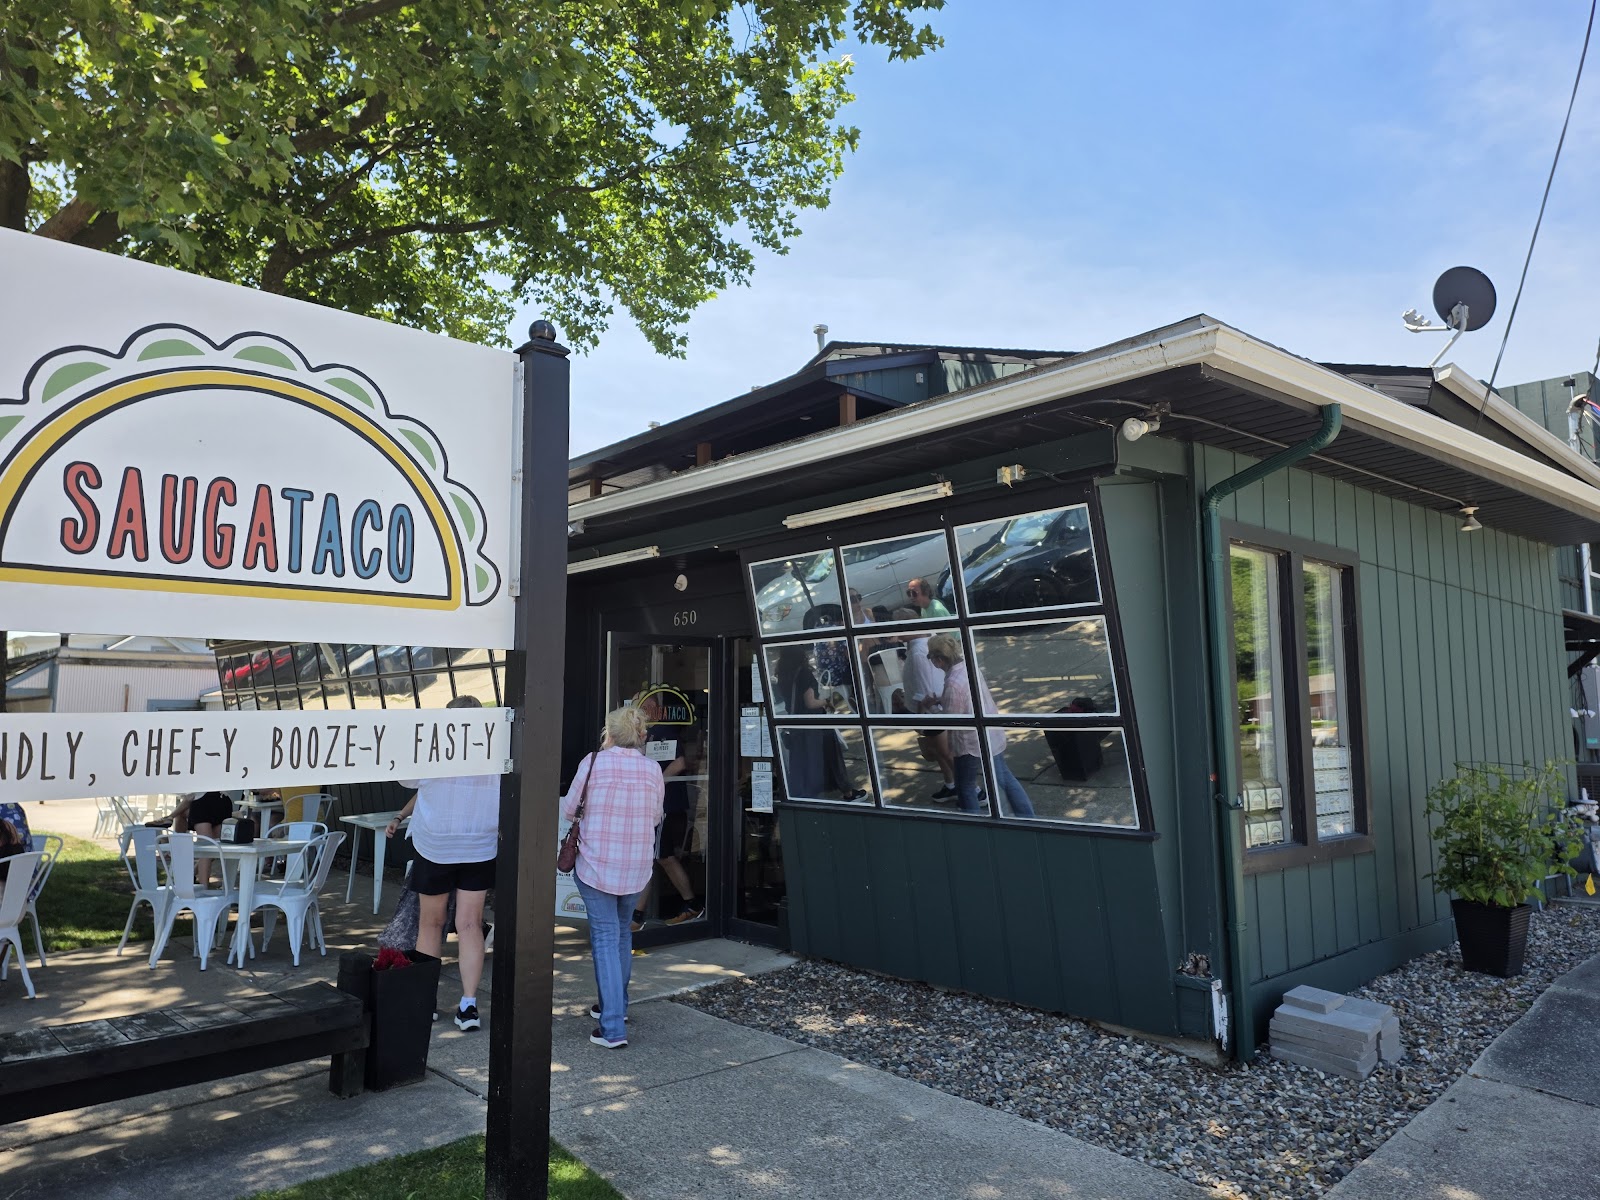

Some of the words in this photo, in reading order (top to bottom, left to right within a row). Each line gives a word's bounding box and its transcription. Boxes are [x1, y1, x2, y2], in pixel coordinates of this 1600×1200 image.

[60, 461, 415, 583] SAUGATACO
[673, 610, 697, 626] 650
[121, 728, 249, 778] CHEF-Y,
[270, 724, 396, 771] BOOZE-Y,
[413, 722, 495, 764] FAST-Y
